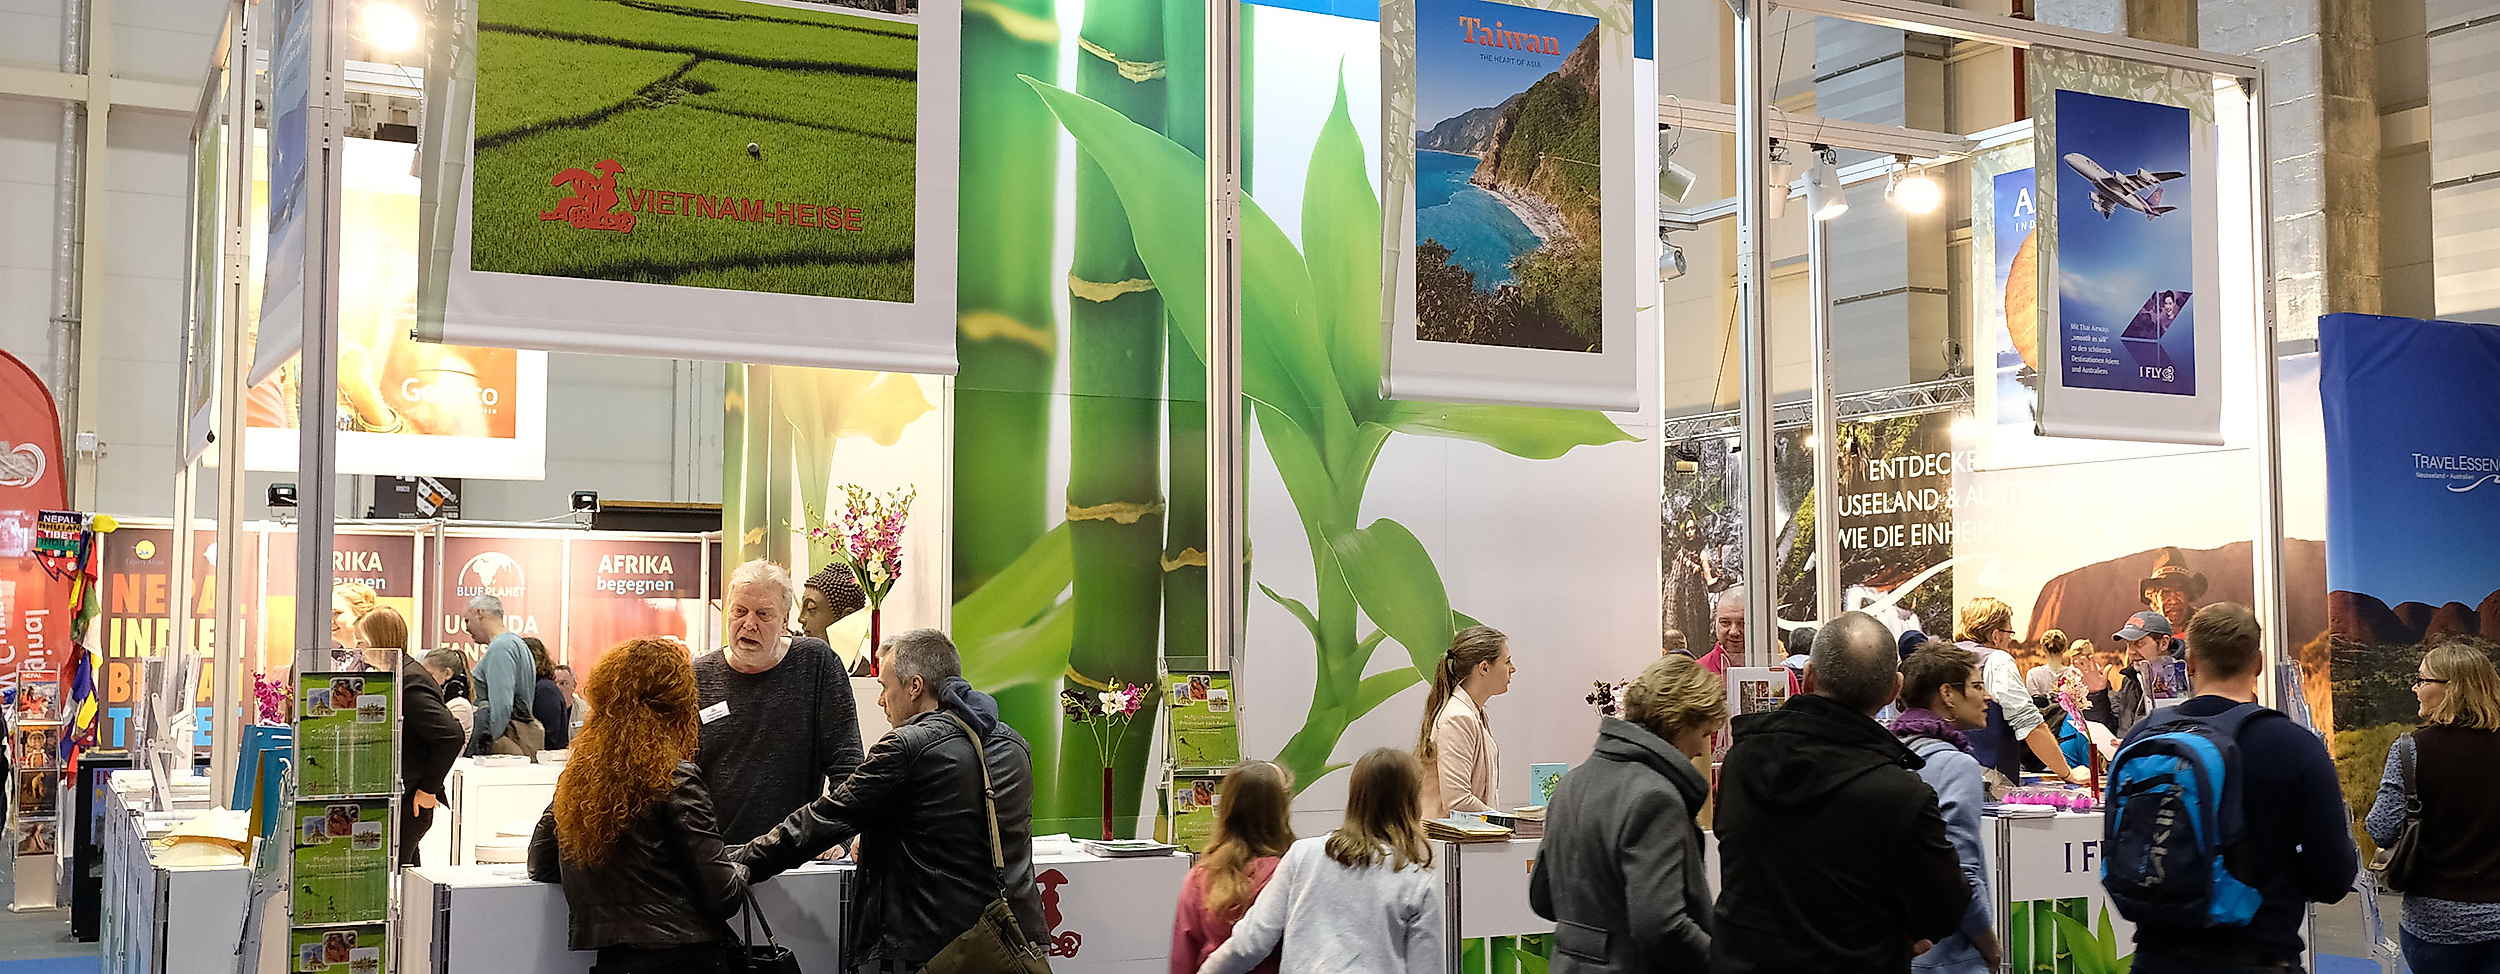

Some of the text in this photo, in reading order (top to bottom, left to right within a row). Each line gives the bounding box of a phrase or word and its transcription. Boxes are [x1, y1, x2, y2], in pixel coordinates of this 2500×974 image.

[1459, 16, 1560, 55] Taiwan
[1480, 53, 1541, 68] THE HEART OF ASIA
[626, 187, 863, 232] VIETNAM-HEISE
[2080, 323, 2090, 331] Thai
[1869, 451, 1976, 481] ENTDECKE
[2411, 453, 2500, 472] TRAVELESSEN
[1838, 488, 1939, 517] USEELAND
[43, 514, 77, 524] NEPAL
[44, 530, 75, 540] TIBET
[1873, 525, 1905, 547] DIE
[333, 551, 383, 571] RIKA
[598, 554, 674, 574] AFRIKA
[596, 575, 674, 595] begegnen
